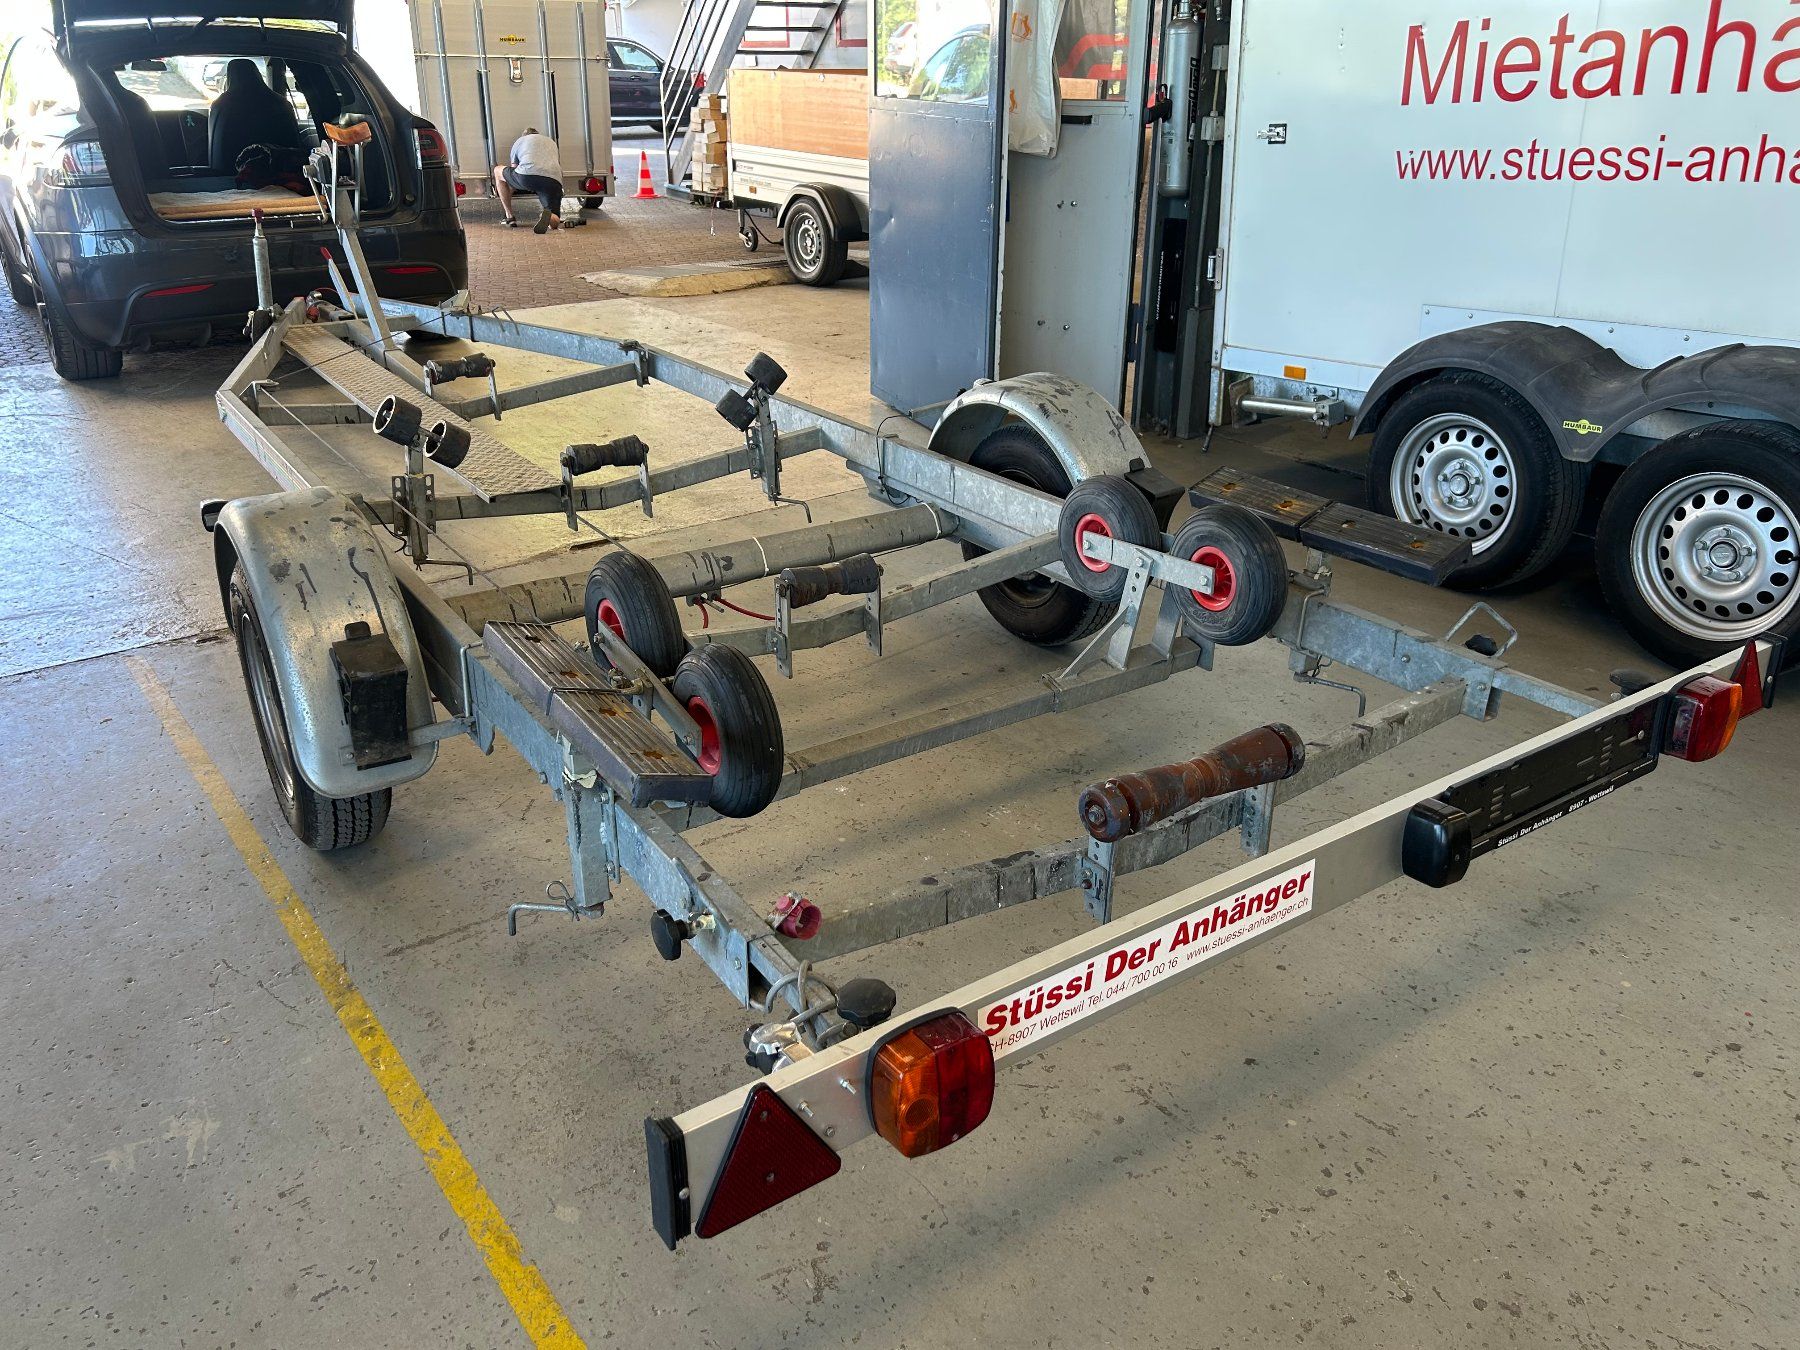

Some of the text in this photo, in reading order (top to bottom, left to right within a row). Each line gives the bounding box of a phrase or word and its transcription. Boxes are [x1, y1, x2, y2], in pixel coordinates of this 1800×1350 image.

[1564, 421, 1602, 432] HUMBAUR
[1498, 833, 1518, 846] Stüssi
[1533, 811, 1563, 829] Anhänger
[1569, 800, 1584, 812] 8907
[984, 870, 1312, 1037] Stüssi Der Anhänger
[1039, 1000, 1085, 1031] Wettswil
[1087, 993, 1104, 1008] Tel.
[1106, 968, 1151, 999] 044/700
[1152, 962, 1165, 977] 00
[1168, 956, 1179, 970] 16
[1186, 896, 1309, 961] www.stuessi-anhaenger.ch
